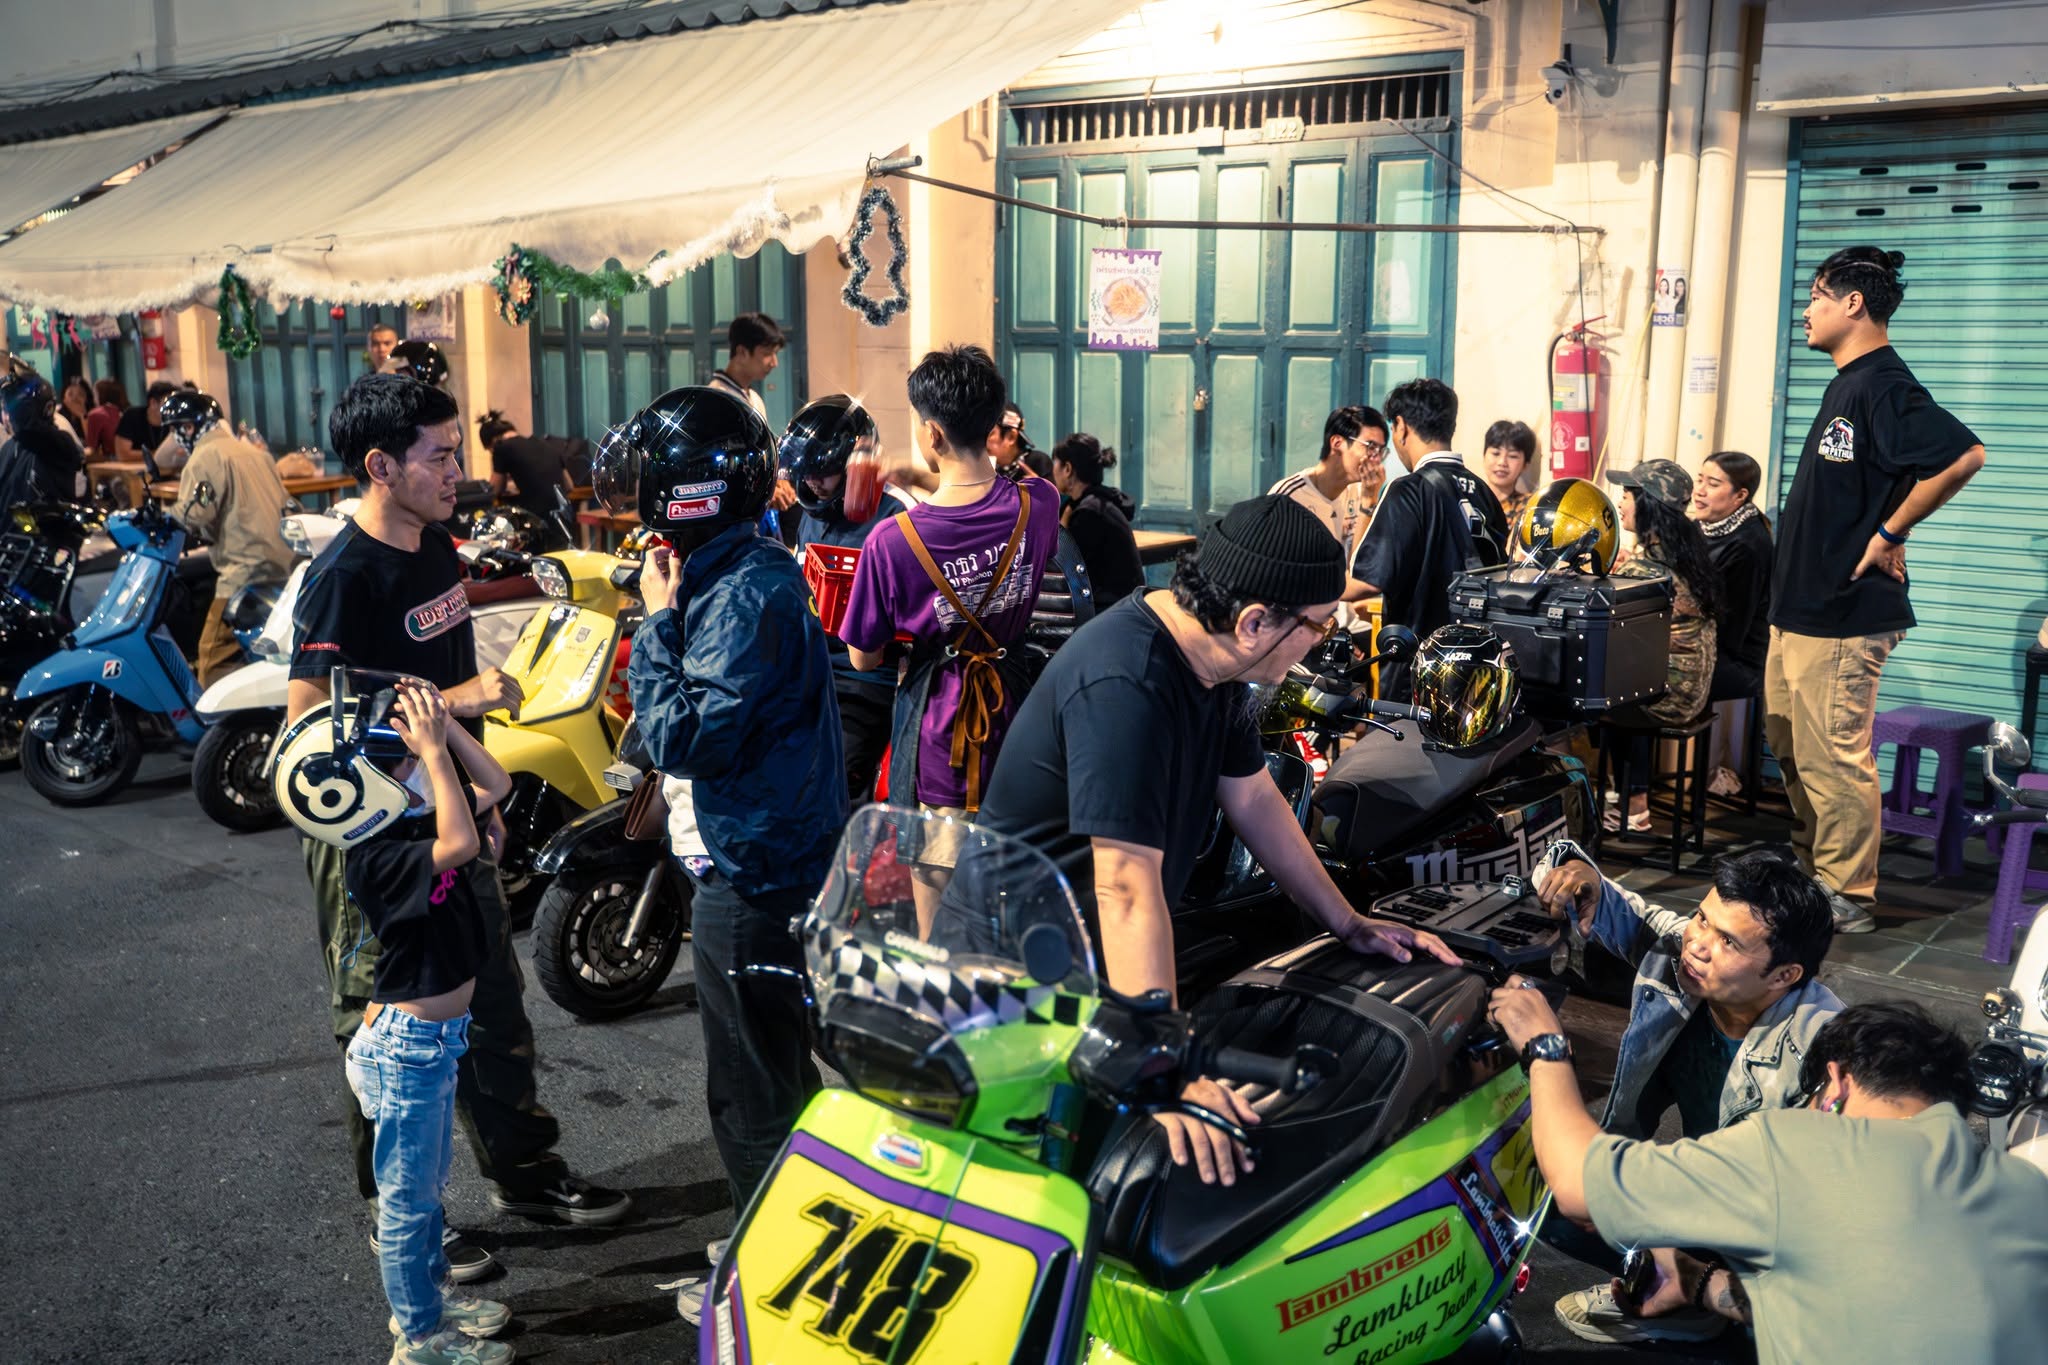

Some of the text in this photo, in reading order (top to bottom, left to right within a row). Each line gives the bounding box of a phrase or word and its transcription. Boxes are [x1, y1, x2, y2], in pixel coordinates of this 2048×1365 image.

[1443, 652, 1472, 661] LAZER
[758, 1194, 978, 1365] 748
[1275, 1216, 1452, 1334] Lambretta
[1323, 1250, 1467, 1356] Lamkluay
[1352, 1279, 1478, 1365] Racing Team
